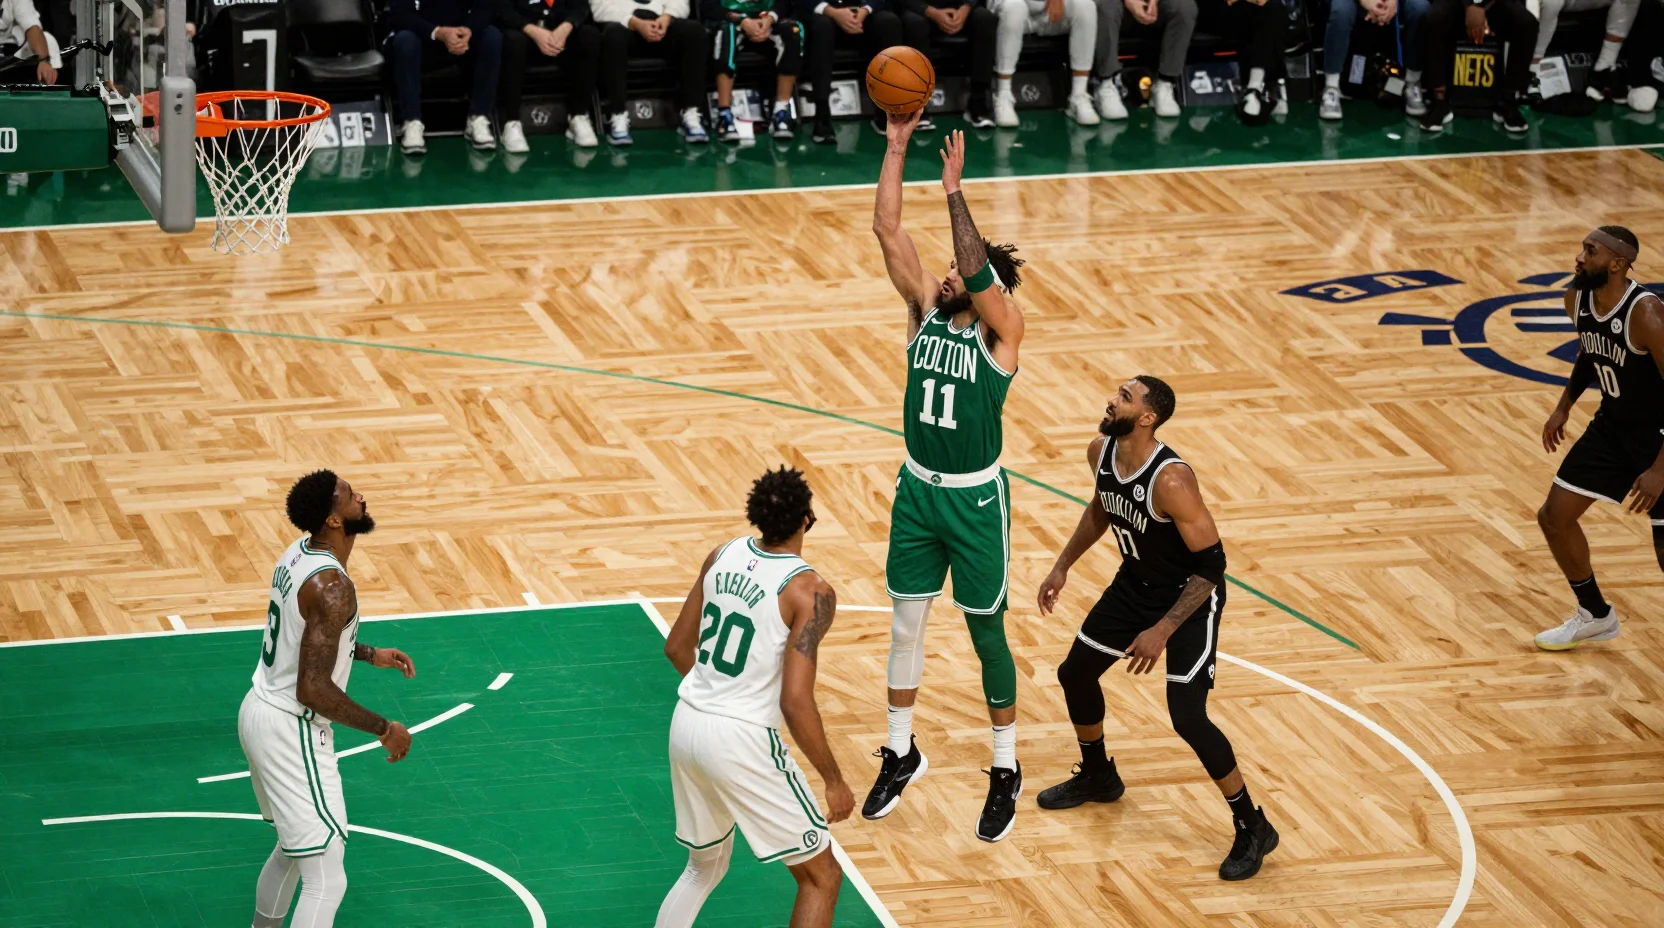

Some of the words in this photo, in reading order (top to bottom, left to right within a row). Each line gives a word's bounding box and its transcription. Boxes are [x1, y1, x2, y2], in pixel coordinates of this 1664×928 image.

[1453, 53, 1495, 88] NETS
[913, 334, 978, 384] COLTON
[919, 378, 957, 430] 11
[697, 601, 757, 678] 20
